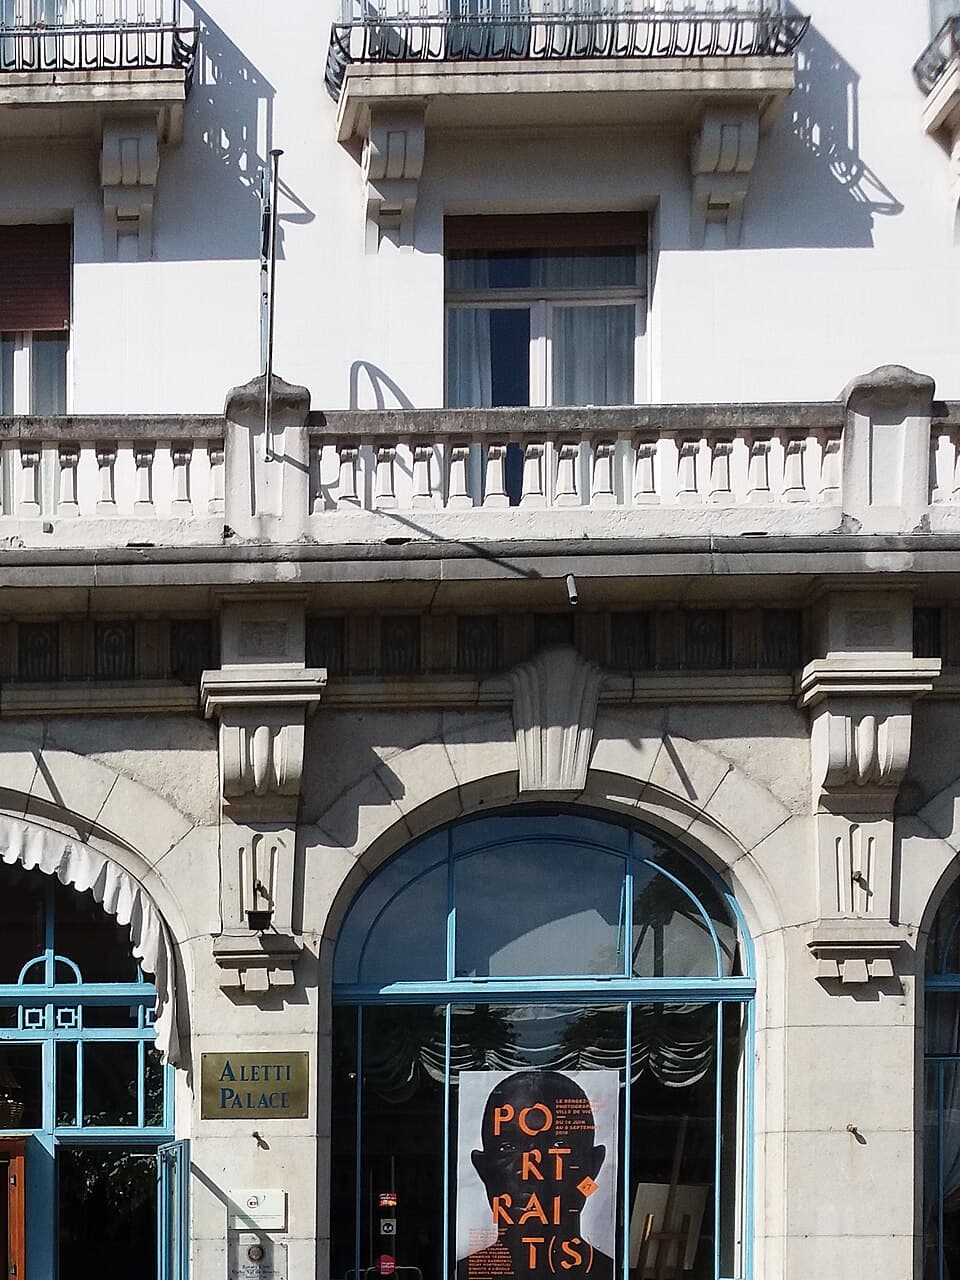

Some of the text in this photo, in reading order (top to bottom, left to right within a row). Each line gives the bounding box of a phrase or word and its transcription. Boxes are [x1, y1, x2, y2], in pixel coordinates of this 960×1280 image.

[219, 1060, 291, 1081] ALETTI
[220, 1087, 290, 1109] PALACE
[493, 1102, 553, 1136] PO
[521, 1235, 594, 1274] T(S)
